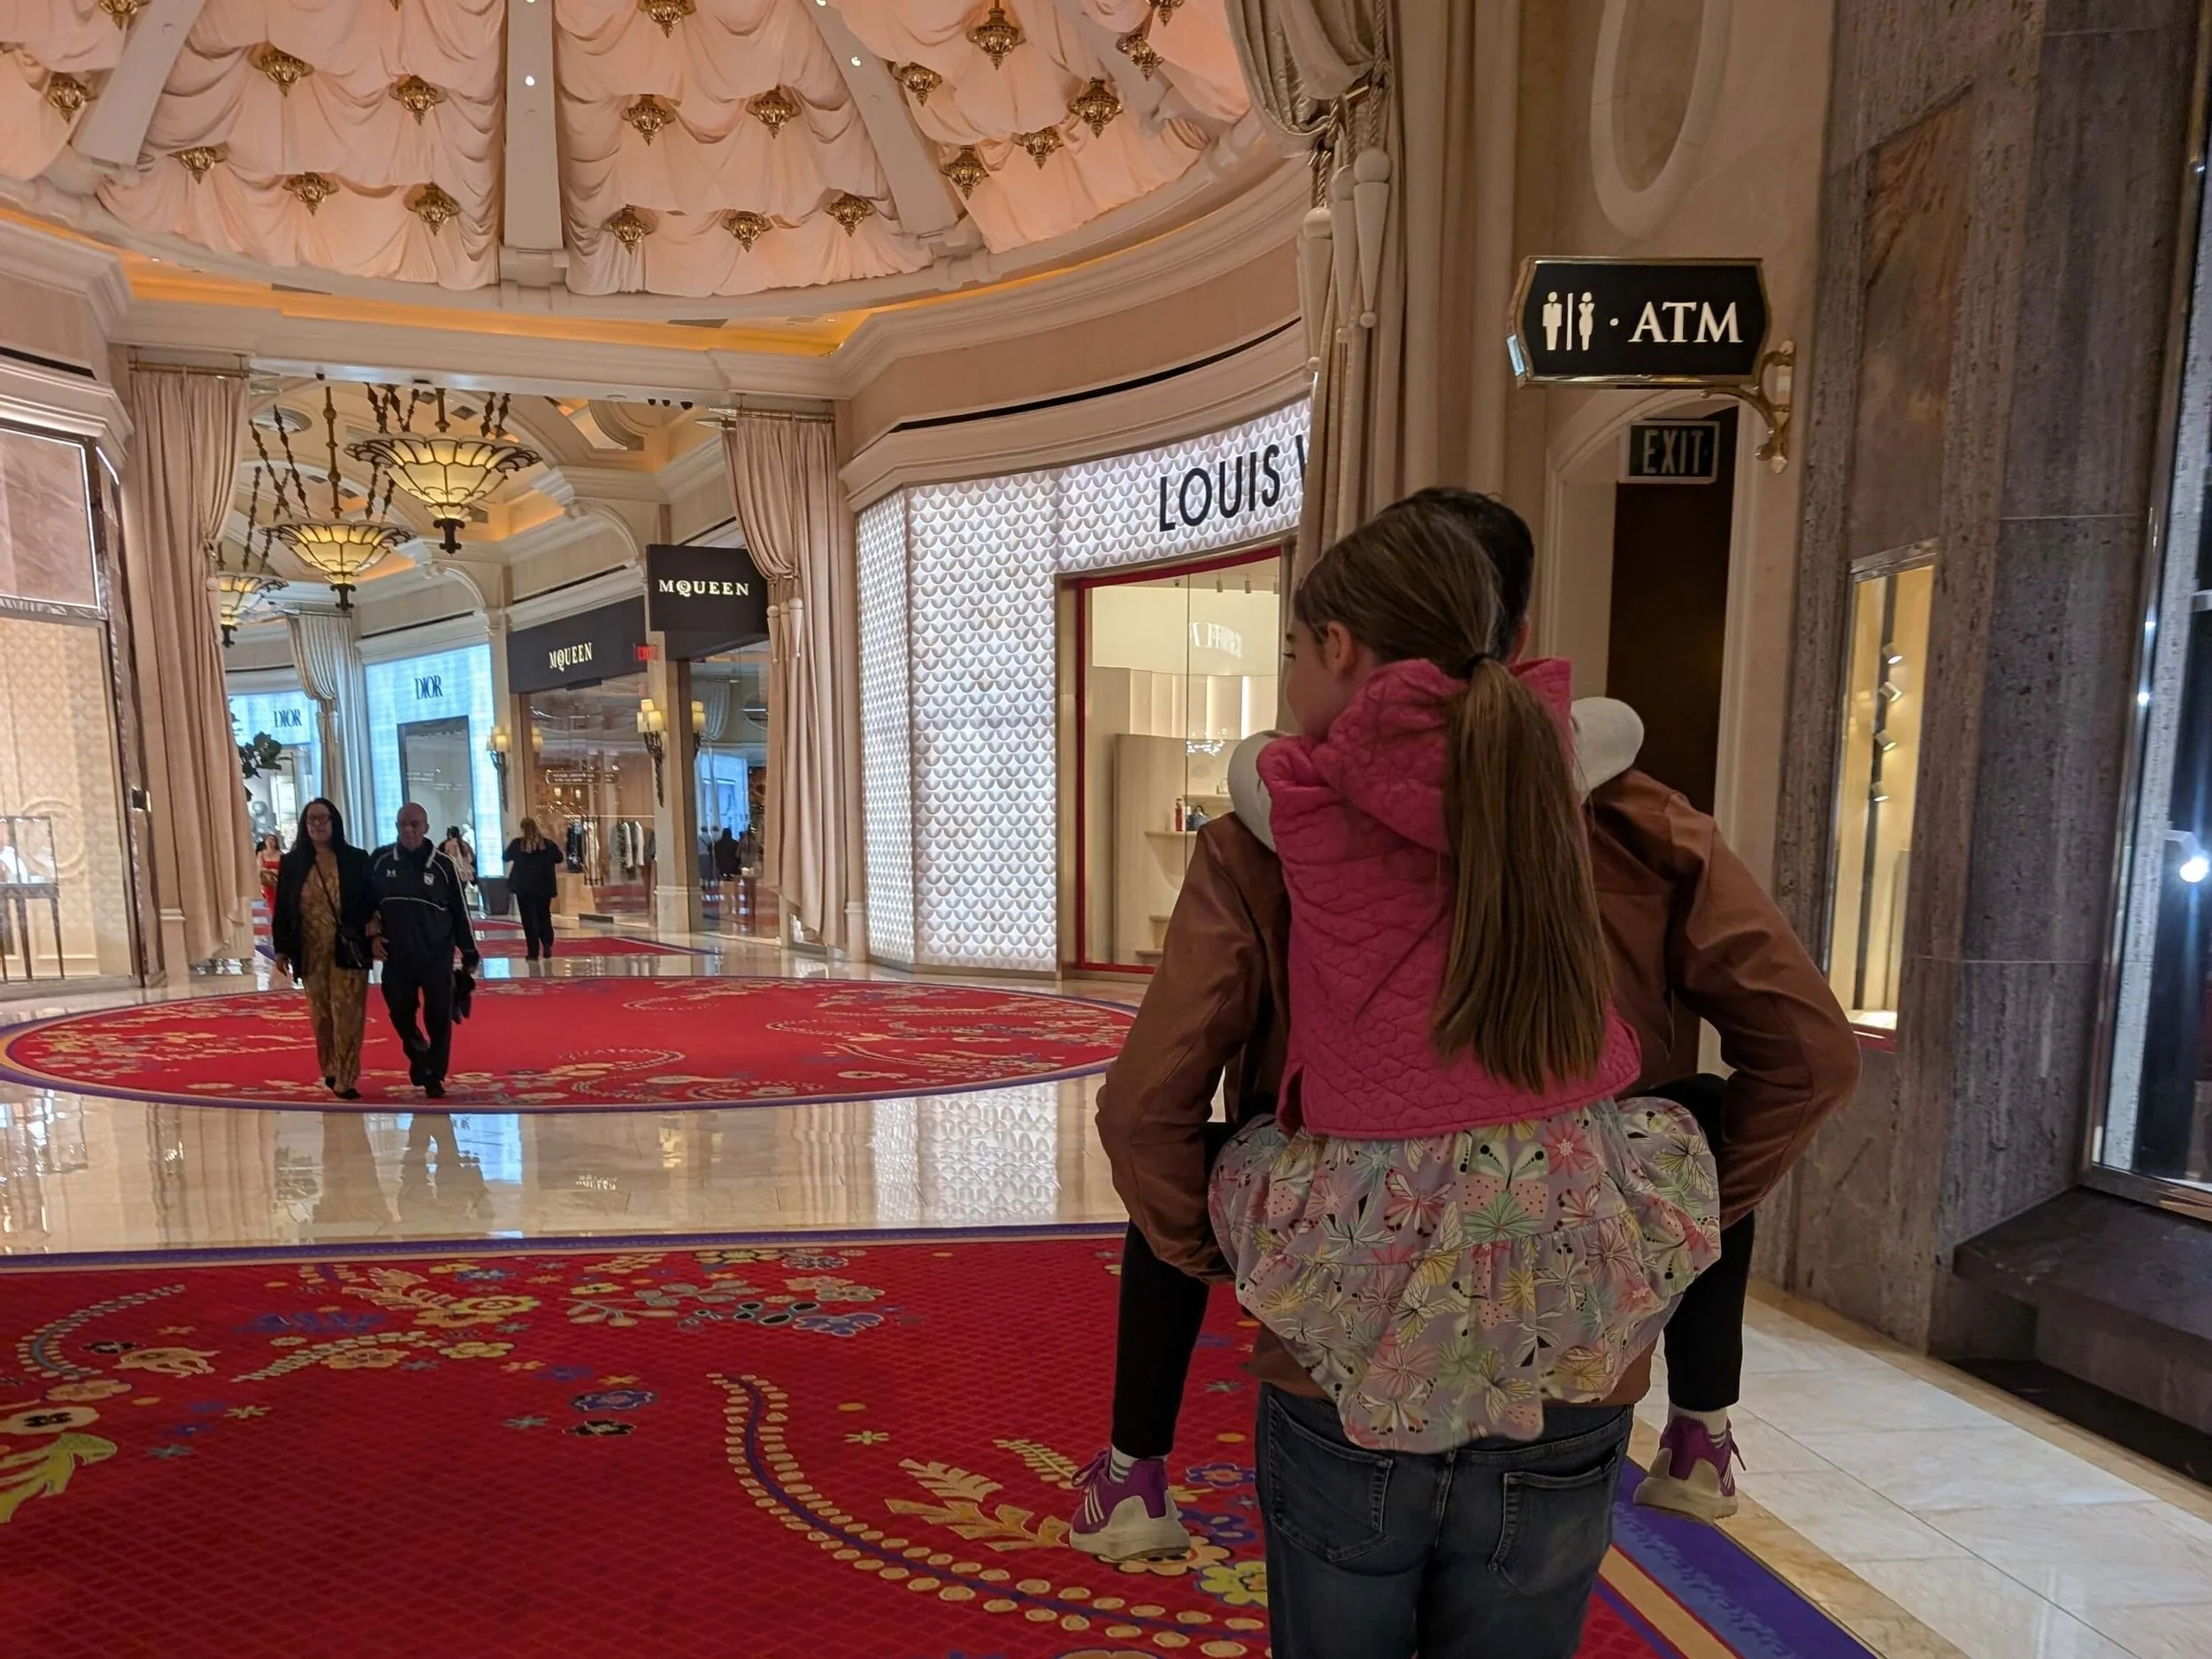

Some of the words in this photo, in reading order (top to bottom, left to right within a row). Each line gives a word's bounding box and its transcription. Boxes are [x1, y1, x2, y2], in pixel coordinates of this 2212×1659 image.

[1628, 302, 1743, 343] ATM
[1642, 429, 1705, 474] EXIT
[1157, 443, 1280, 532] LOUIS
[415, 675, 443, 700] DIOR
[273, 709, 302, 728] DIOR
